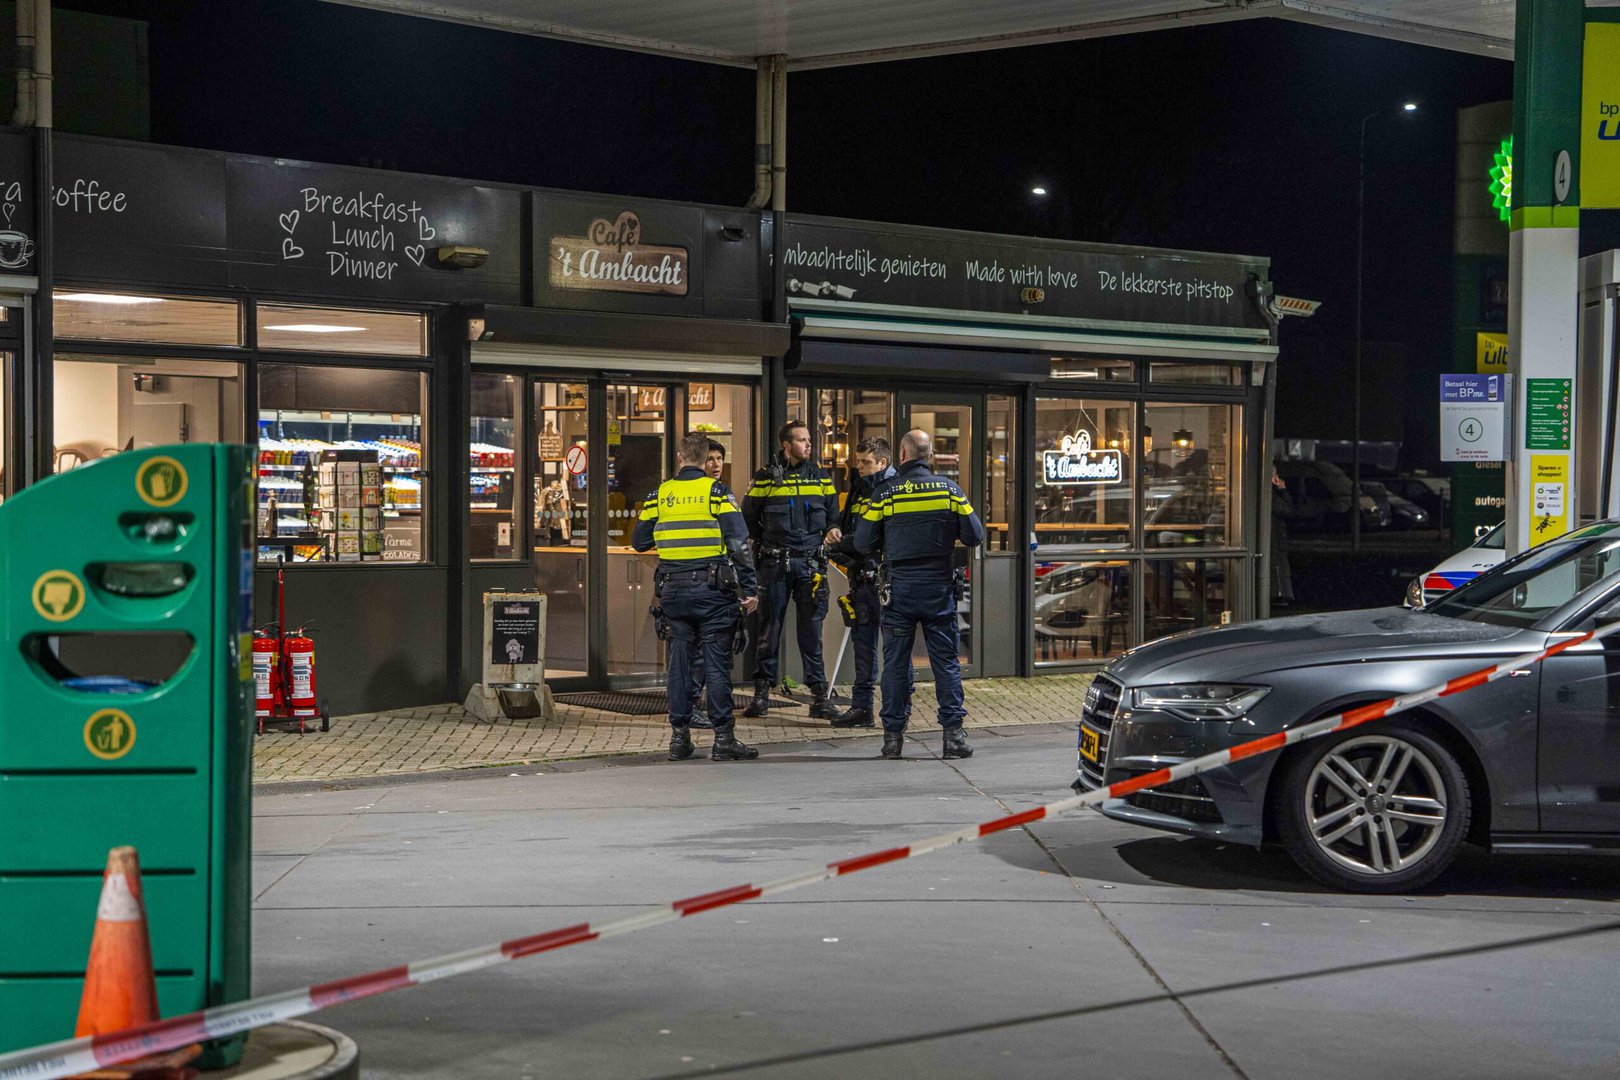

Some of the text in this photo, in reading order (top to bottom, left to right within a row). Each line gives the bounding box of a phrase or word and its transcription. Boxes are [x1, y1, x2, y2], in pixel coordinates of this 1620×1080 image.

[1600, 101, 1619, 117] bp
[1559, 162, 1566, 188] 4
[52, 179, 127, 213] offee
[300, 187, 422, 223] Breakfast
[332, 220, 394, 251] Lunch
[326, 251, 398, 279] Dinner
[579, 249, 682, 285] Ambacht
[881, 254, 947, 283] genieten
[966, 260, 1005, 282] Made
[1009, 264, 1043, 286] with
[1098, 271, 1234, 304] De lekkerste pitstop
[1465, 423, 1474, 436] 4
[1058, 455, 1118, 478] Ambacht
